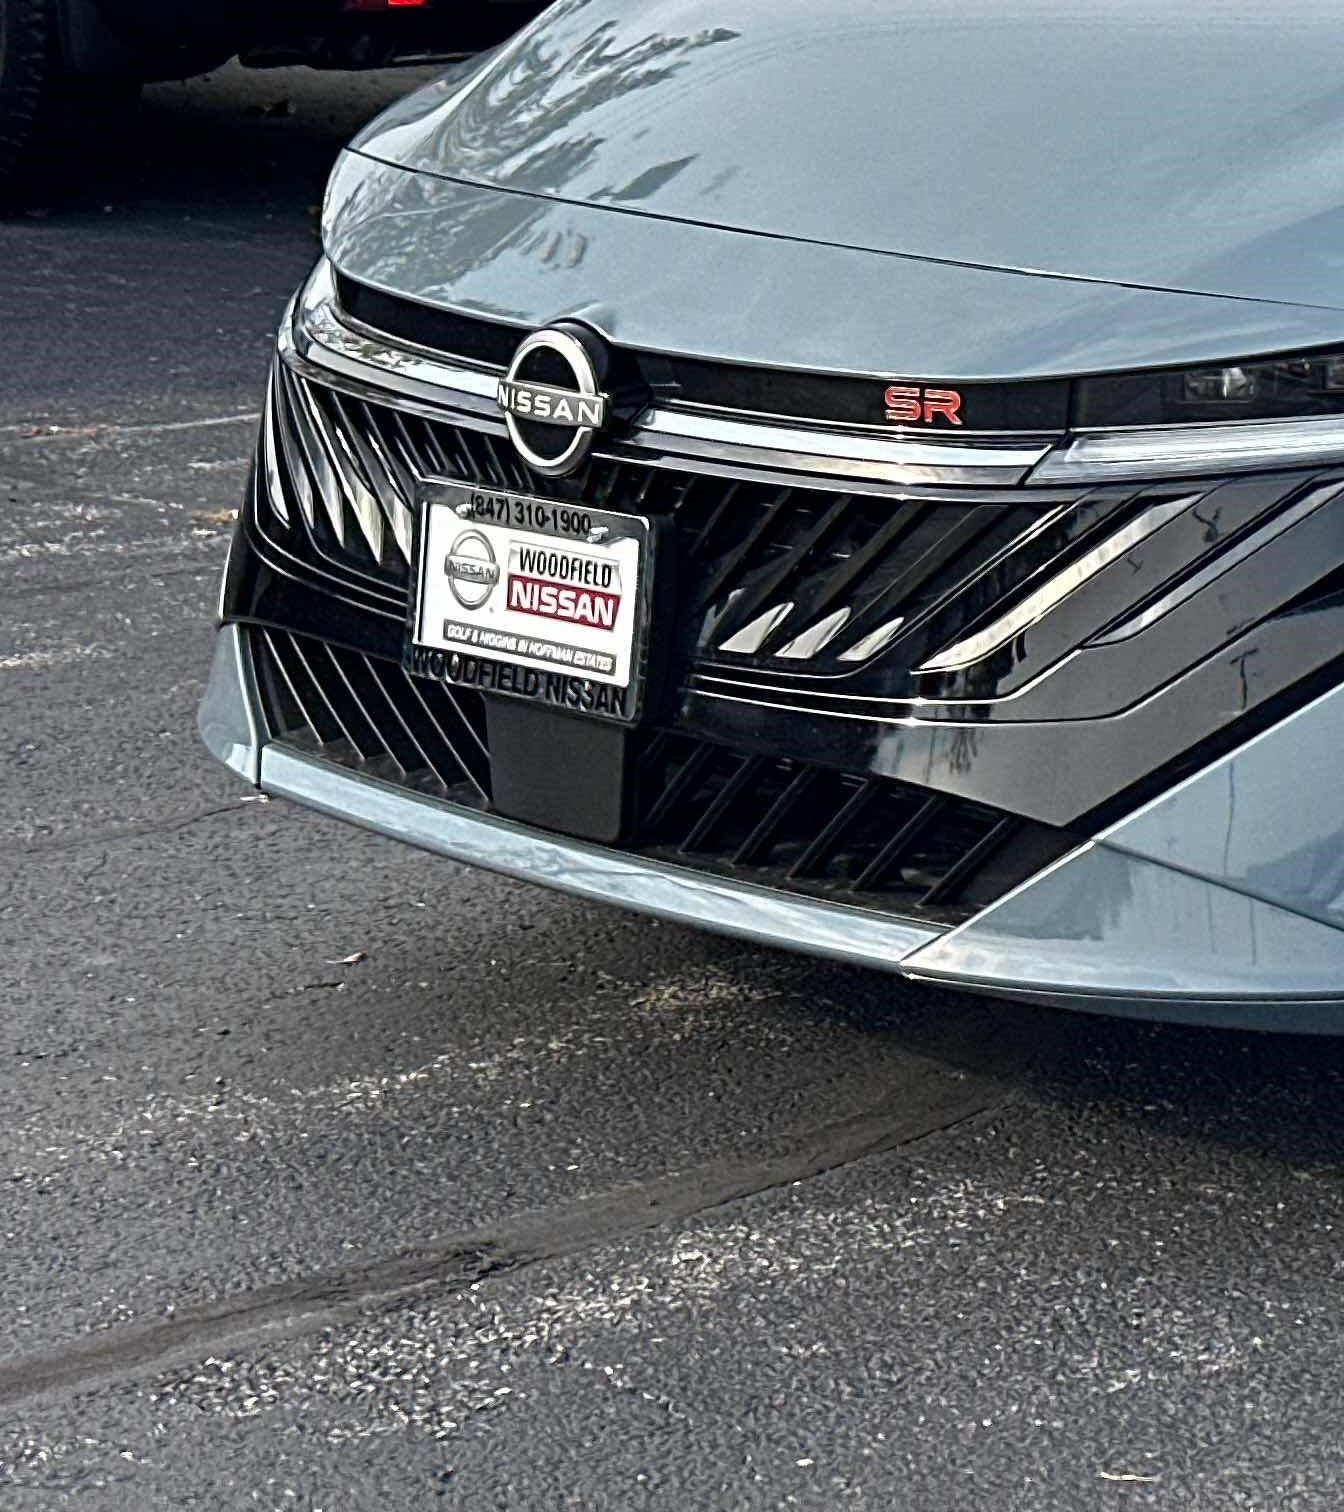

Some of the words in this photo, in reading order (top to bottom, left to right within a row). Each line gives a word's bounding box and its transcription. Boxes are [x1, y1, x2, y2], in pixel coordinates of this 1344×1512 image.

[498, 384, 600, 425] NISSAN
[885, 386, 962, 425] SR
[470, 490, 511, 525] (847)
[514, 500, 592, 535] 310-1900
[519, 546, 612, 588] WOODFIELD
[510, 579, 615, 626] NISSAN
[412, 648, 542, 698] WOODFIELD
[545, 672, 627, 718] NISSAN
